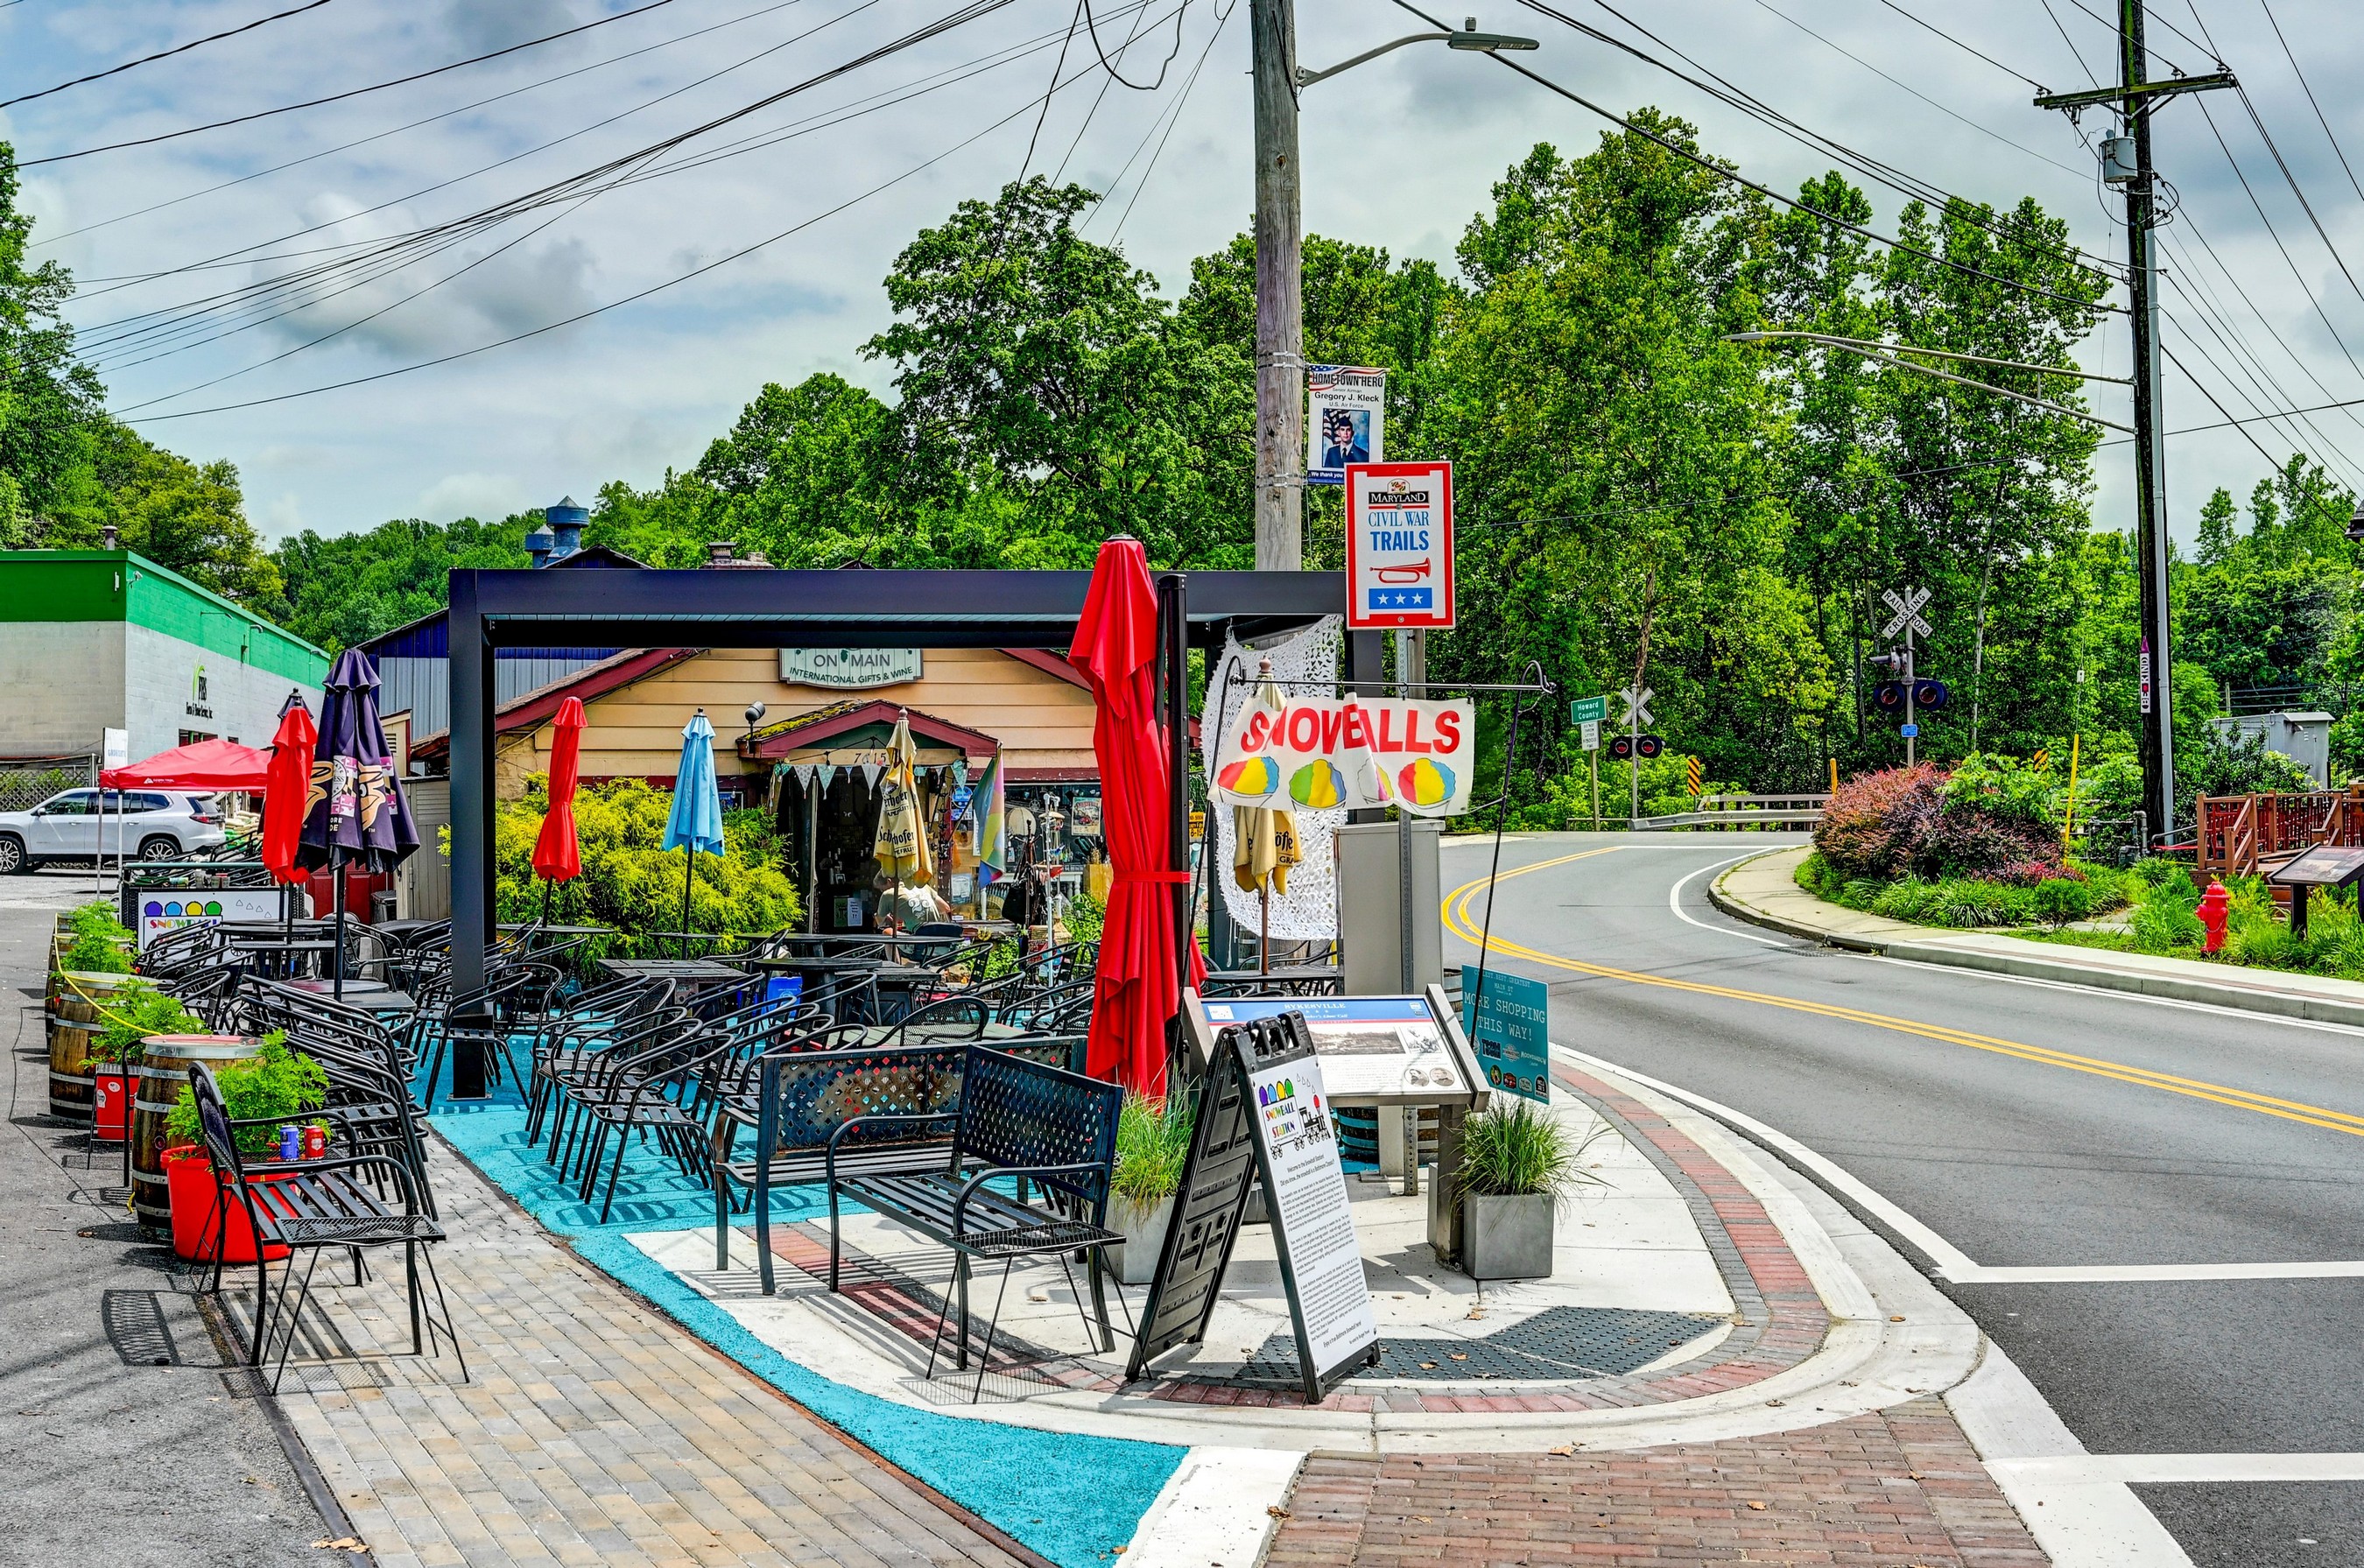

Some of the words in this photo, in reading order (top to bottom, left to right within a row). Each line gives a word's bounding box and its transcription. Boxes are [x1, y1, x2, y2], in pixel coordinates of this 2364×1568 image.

[1312, 373, 1359, 386] HOMETOWN
[1361, 376, 1383, 388] HERO
[1314, 391, 1346, 402] Gregory
[1370, 492, 1426, 504] MARYLAND
[1368, 511, 1403, 527] CIVIL
[1404, 511, 1430, 526] WAR
[1370, 531, 1430, 552] TRAILS
[1884, 592, 1902, 611] RAIL
[1910, 614, 1930, 635] ROAD
[1888, 594, 1925, 634] CROSSING
[813, 654, 837, 667] ON
[851, 654, 890, 667] MAIN
[790, 666, 856, 684] INTERNATIONAL
[857, 673, 882, 684] GIFTS
[890, 666, 913, 679] WINE
[1578, 701, 1599, 711] Howard
[1579, 711, 1599, 720] County
[1464, 991, 1490, 1009] MORE
[1495, 999, 1545, 1024] SHOPPING
[1477, 1016, 1502, 1033] THIS
[1508, 1023, 1532, 1042] WAY!
[1265, 1102, 1296, 1122] SNOWBALL
[1271, 1121, 1296, 1138] STATION
